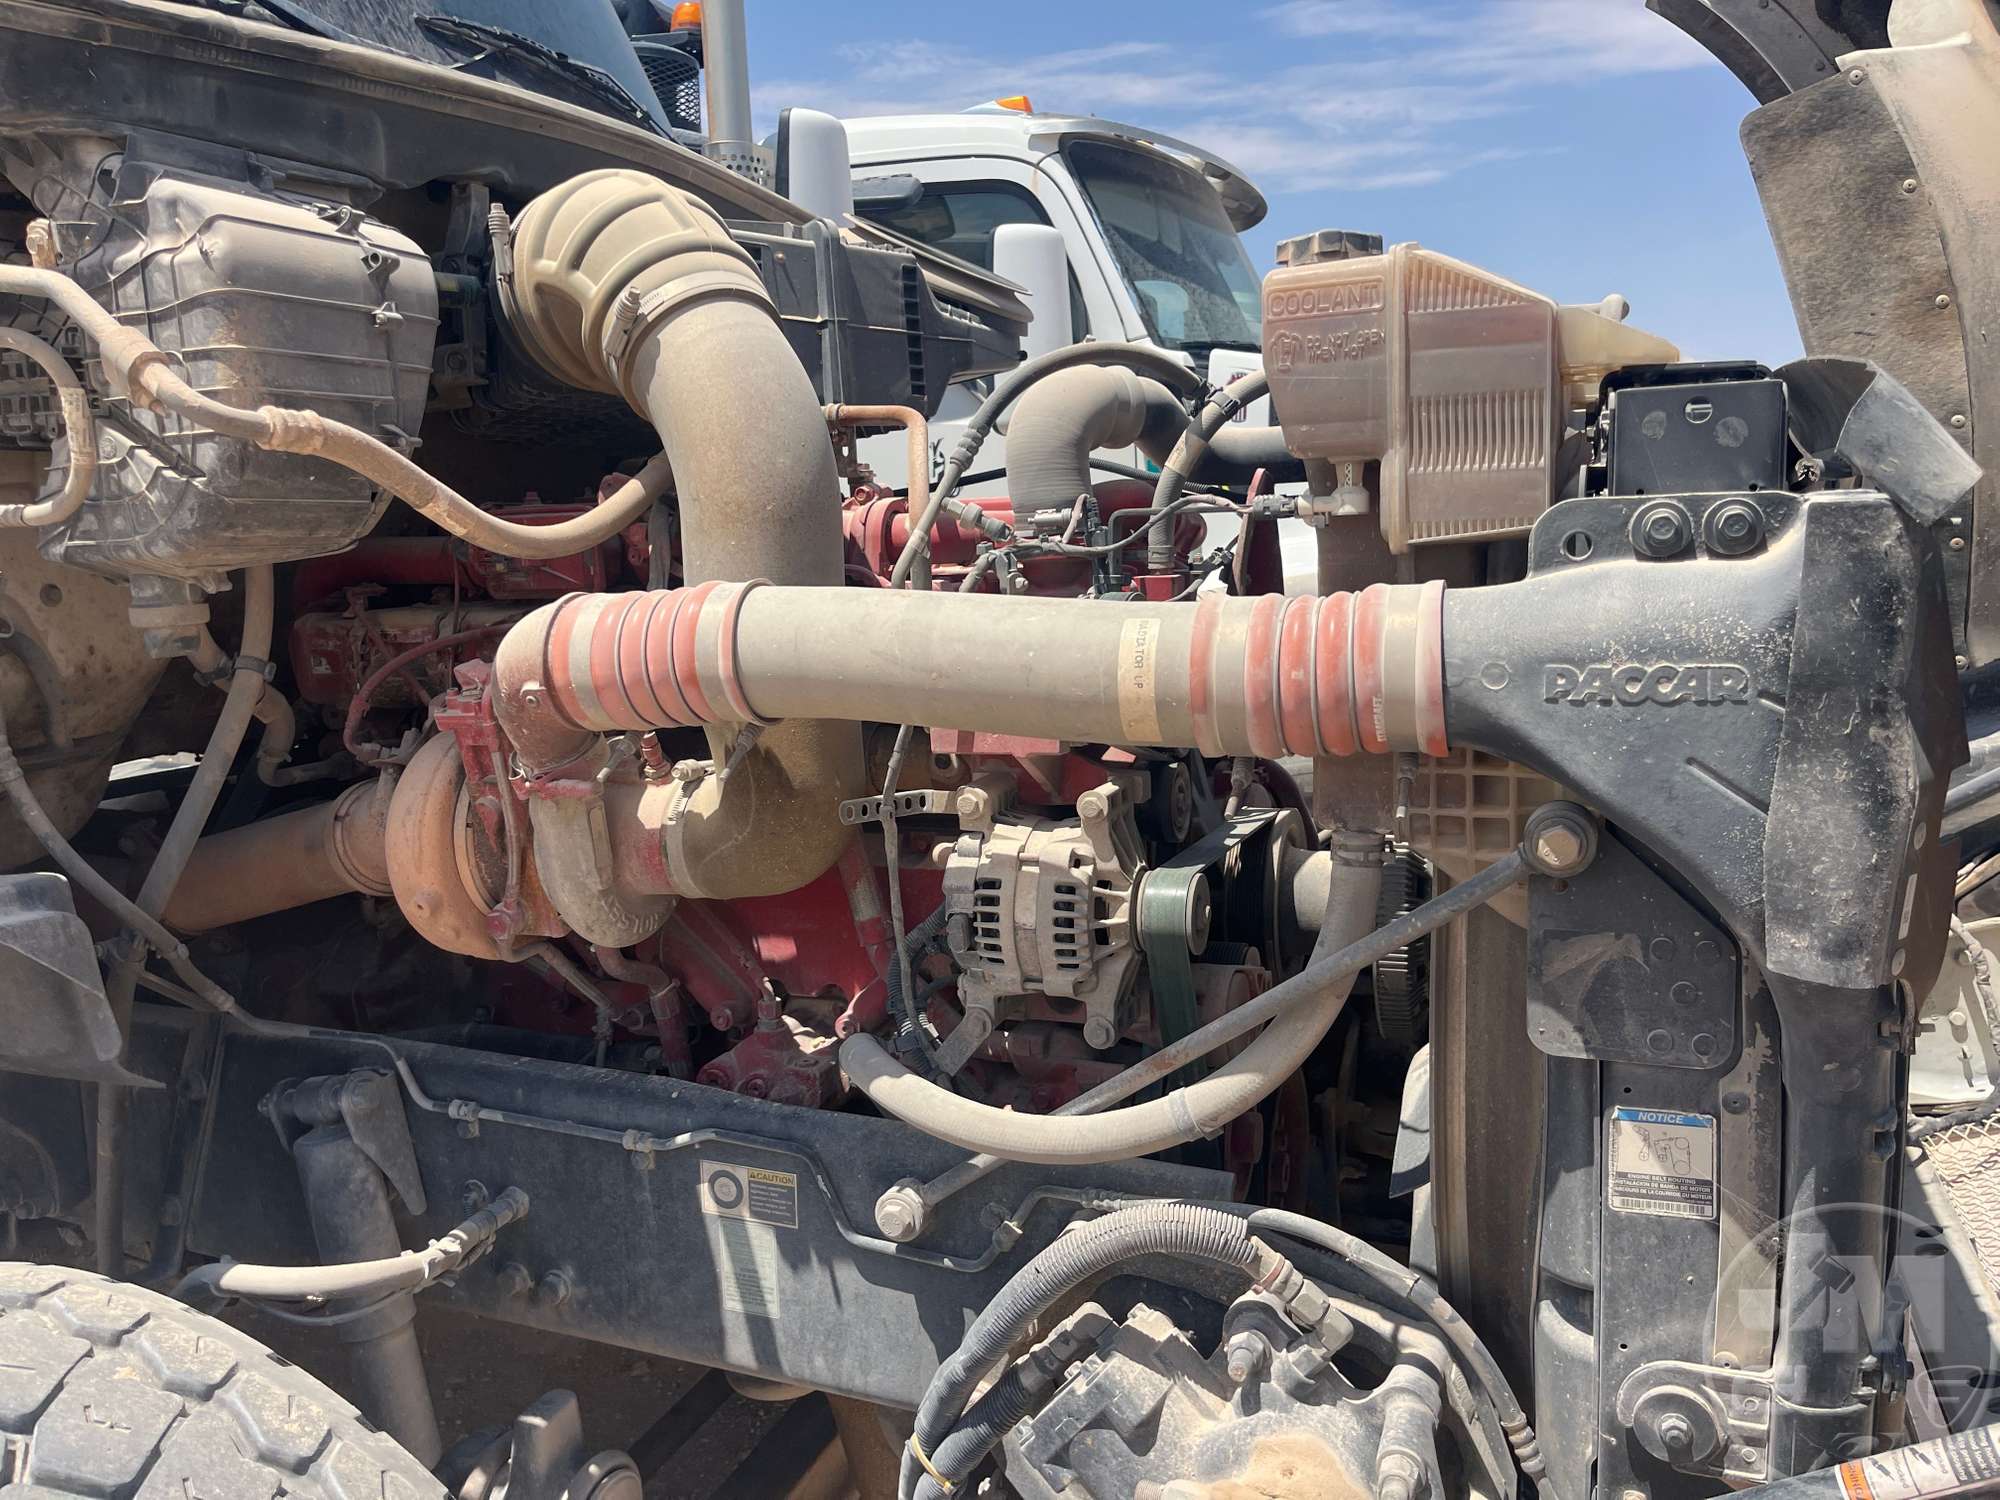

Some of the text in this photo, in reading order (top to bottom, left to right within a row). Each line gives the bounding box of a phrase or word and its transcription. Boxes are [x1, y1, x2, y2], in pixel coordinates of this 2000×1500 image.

[1270, 284, 1378, 316] COOLANT
[1328, 331, 1349, 347] NOT
[1357, 328, 1386, 344] OPEN
[1543, 663, 1750, 708] PACCAR
[1638, 1112, 1684, 1124] NOTICE
[755, 1172, 794, 1185] CAUTION
